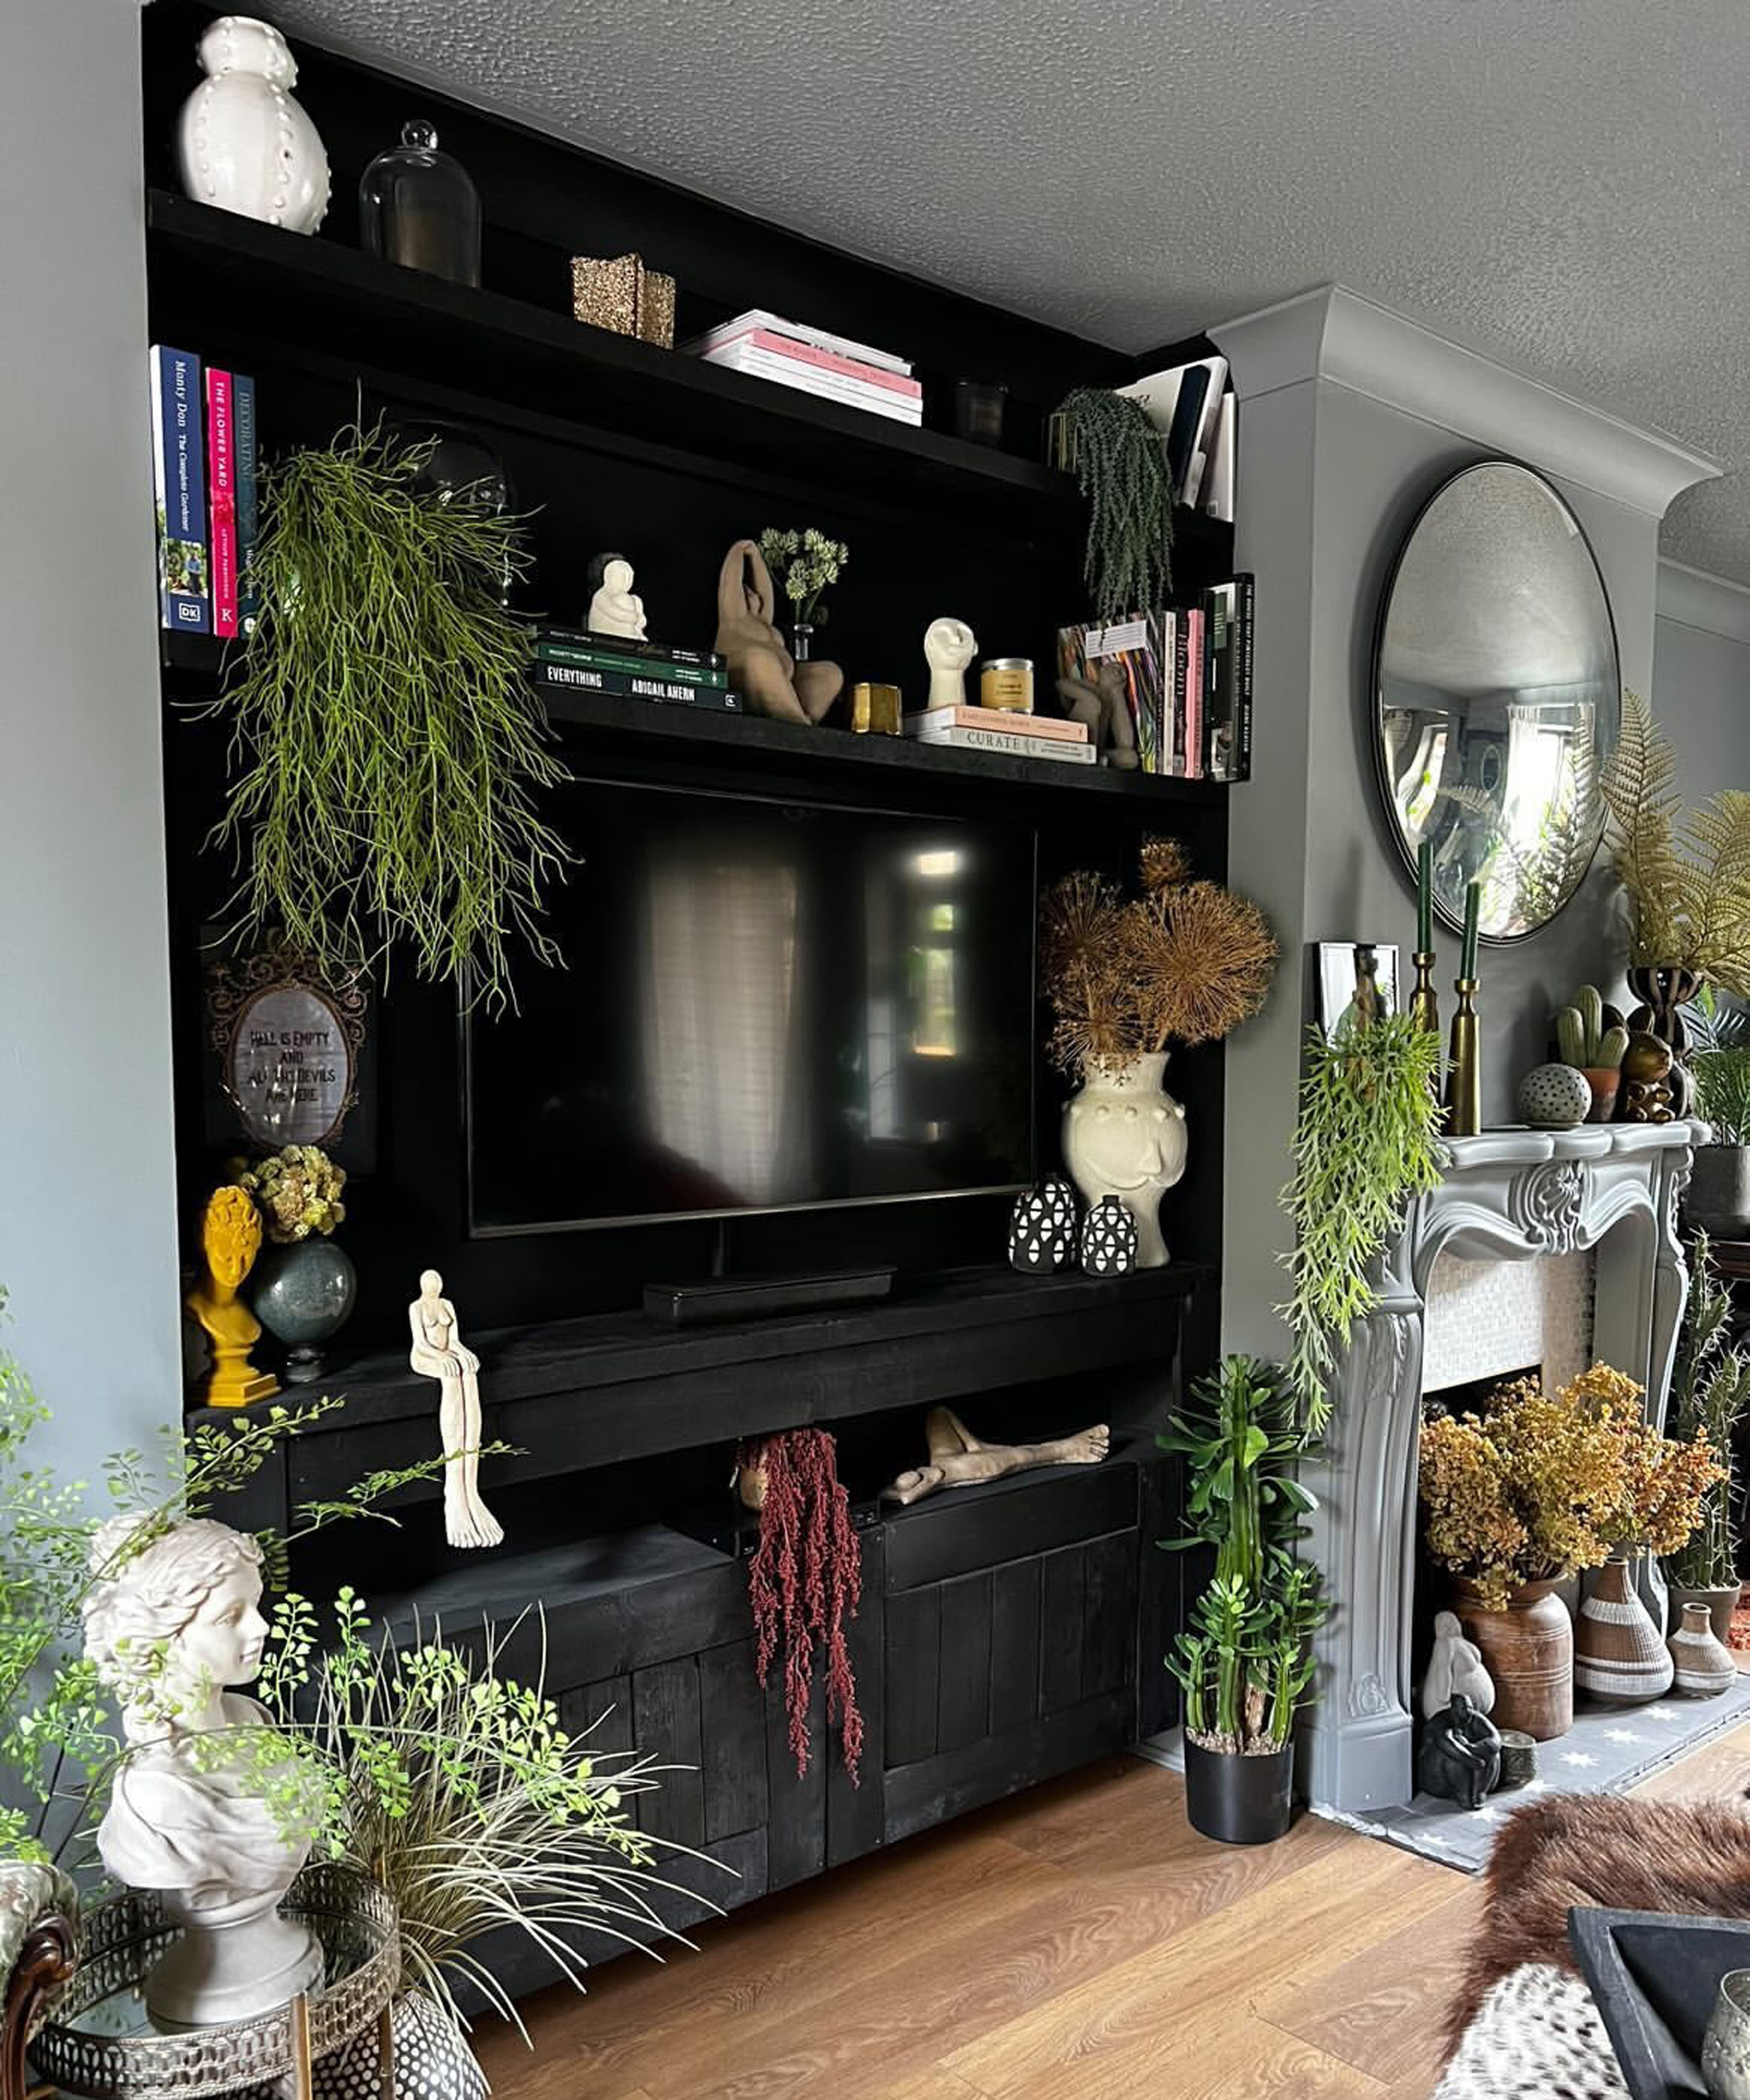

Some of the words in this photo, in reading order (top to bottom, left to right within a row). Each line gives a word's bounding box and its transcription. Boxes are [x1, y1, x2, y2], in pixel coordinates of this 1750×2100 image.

[174, 360, 186, 399] Monty
[216, 382, 225, 404] THE
[176, 402, 187, 427] Don
[216, 407, 226, 453] FLOWER
[178, 434, 186, 451] The
[178, 452, 189, 492] Complete
[217, 457, 228, 487] YARD
[181, 494, 190, 532] Gardener
[181, 606, 199, 619] DK
[221, 607, 233, 623] K
[1177, 633, 1187, 696] Bloom
[547, 666, 602, 688] EVERYTHING
[632, 679, 666, 697] ABIGAIL
[667, 685, 695, 702] AHERN
[967, 732, 1019, 749] CURATE
[280, 1031, 291, 1046] IS
[292, 1030, 330, 1046] EMPTY
[279, 1051, 304, 1065] AND
[298, 1068, 336, 1083] DEVILS
